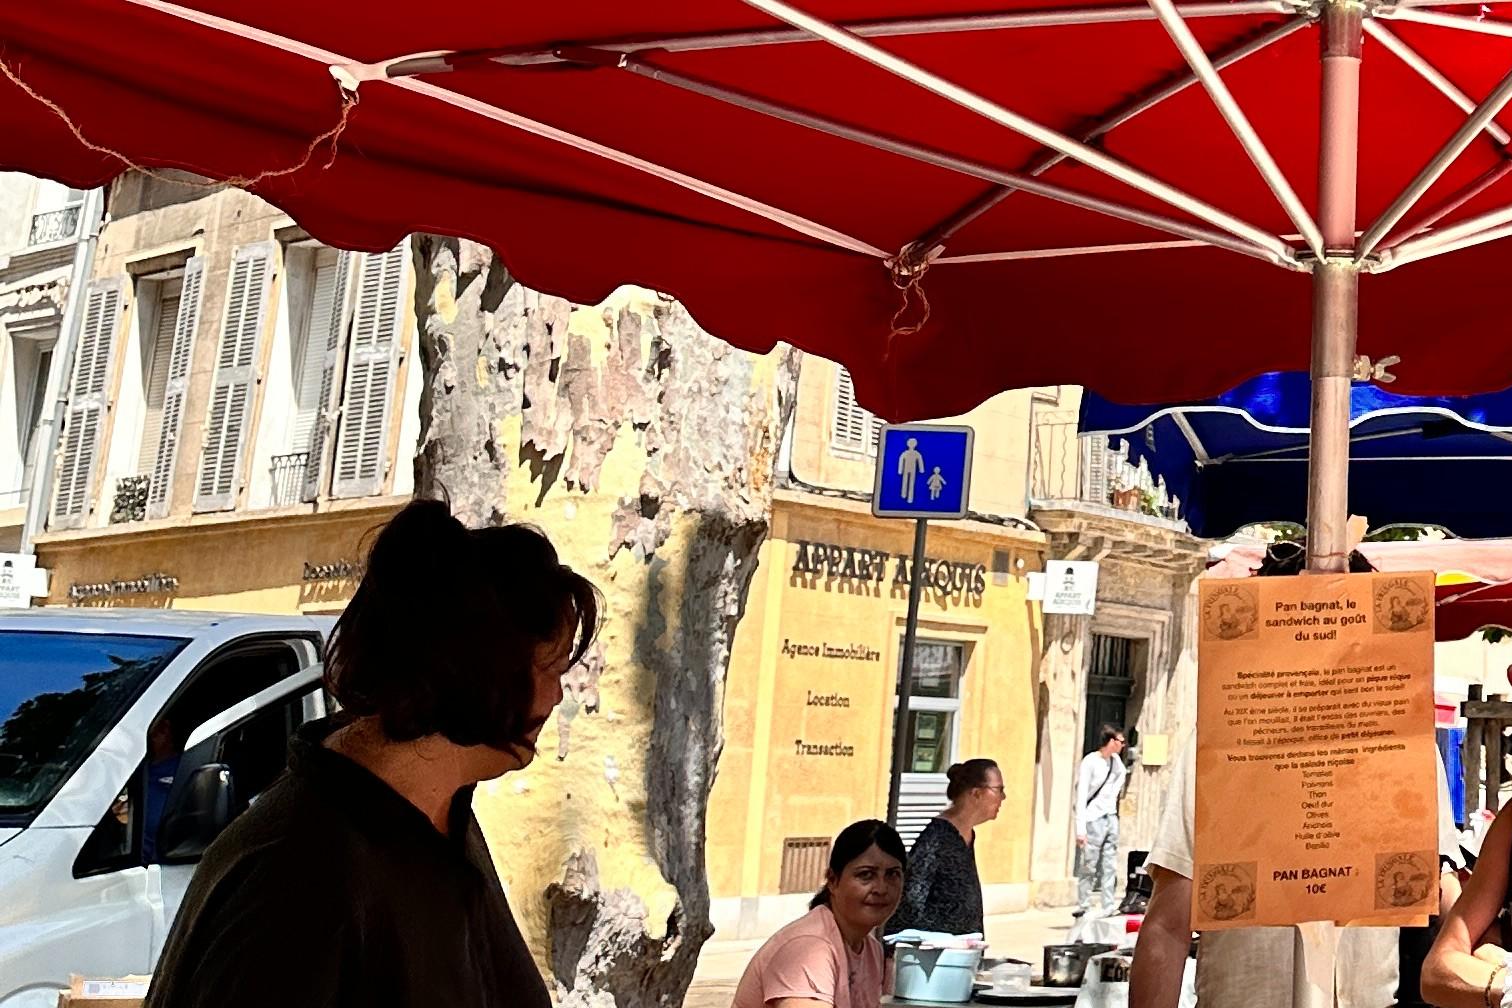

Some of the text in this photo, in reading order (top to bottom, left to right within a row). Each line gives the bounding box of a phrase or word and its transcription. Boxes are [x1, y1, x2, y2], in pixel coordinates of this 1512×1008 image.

[793, 540, 889, 583] APPART
[1274, 600, 1356, 613] Pan bagnat, le
[1265, 613, 1366, 627] sandwich au goût
[1294, 629, 1337, 641] du sud!
[782, 639, 819, 659] Agence
[1332, 668, 1345, 676] pan
[1347, 666, 1373, 674] bagnat
[807, 691, 850, 709] Location
[795, 740, 855, 758] Transaction
[1227, 753, 1246, 762] Vous
[1309, 791, 1327, 799] Thon
[1273, 869, 1298, 881] PAN
[1301, 866, 1353, 880] BAGNAT
[1305, 883, 1327, 894] 10€
